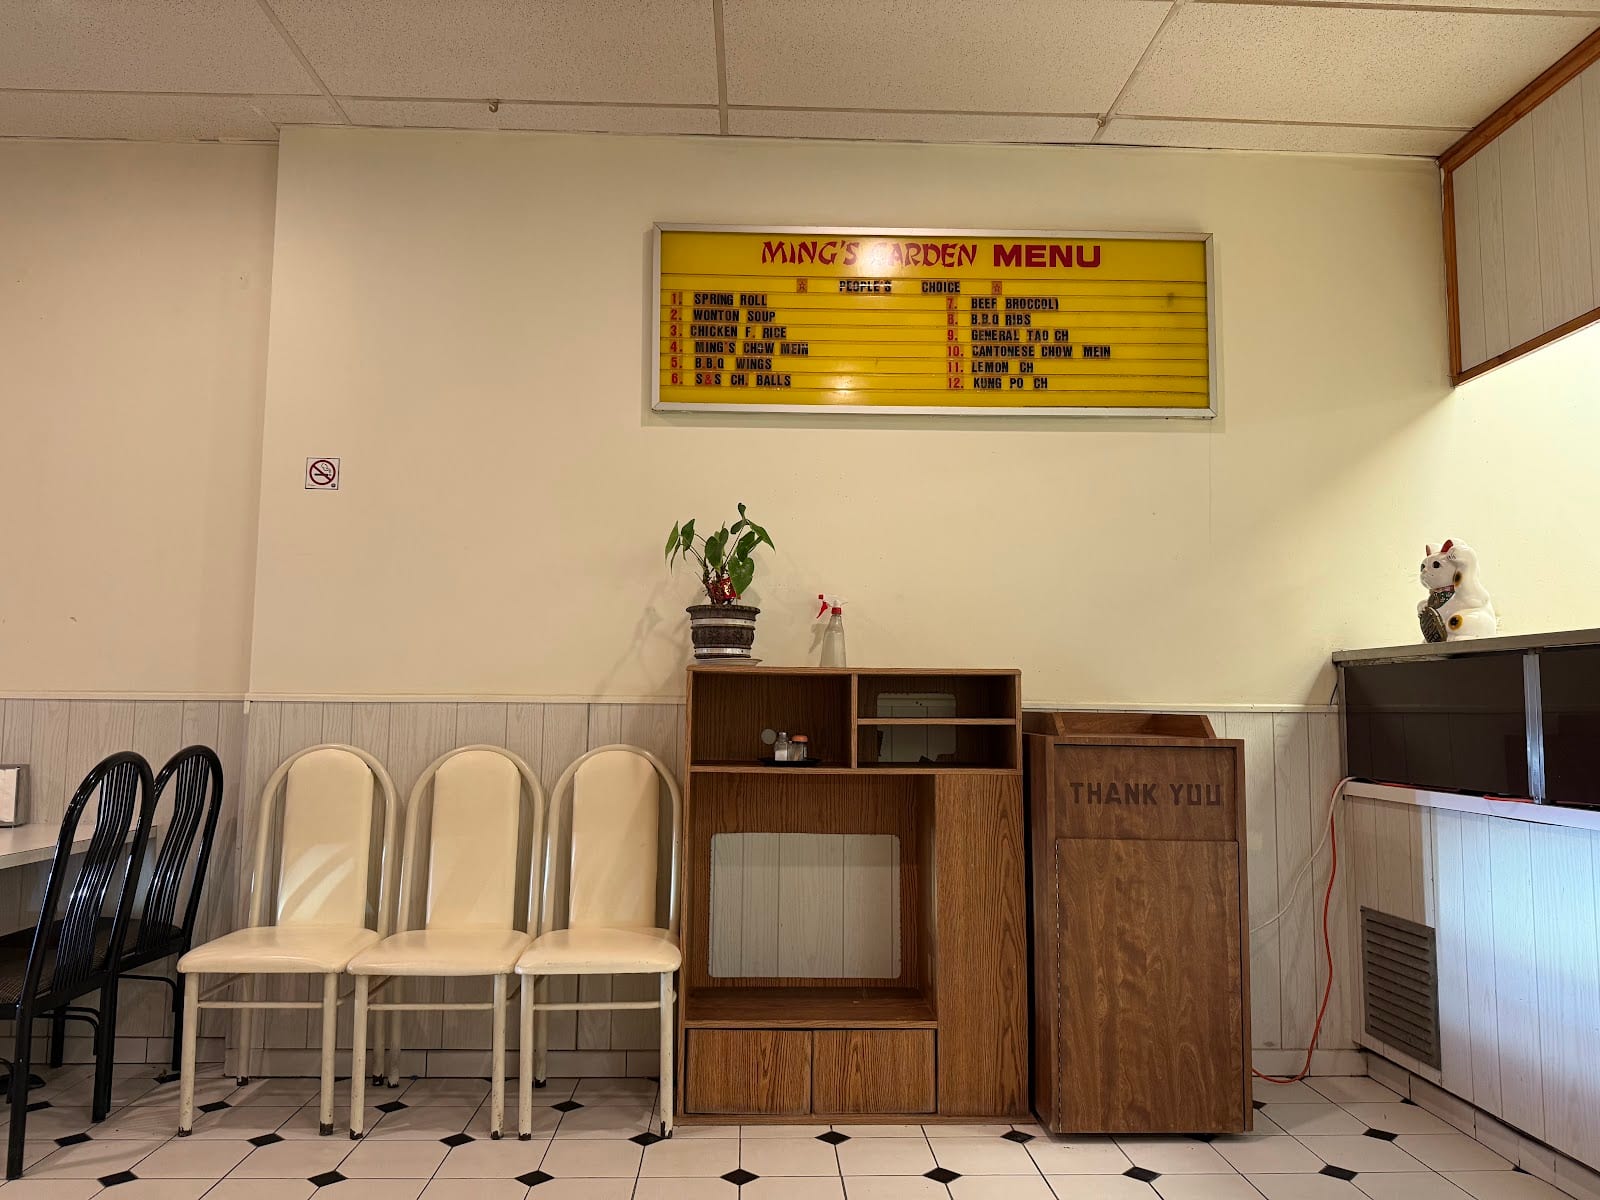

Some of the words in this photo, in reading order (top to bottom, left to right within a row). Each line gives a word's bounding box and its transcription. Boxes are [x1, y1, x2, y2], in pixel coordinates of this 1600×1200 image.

[762, 240, 859, 265] MING'S
[871, 242, 977, 268] ARDEN
[994, 244, 1101, 268] MENU
[840, 281, 892, 292] PEOPLE'S
[921, 281, 960, 293] CHOICE
[671, 293, 682, 305] 1.
[694, 294, 734, 306] SPRING
[740, 294, 767, 306] ROLL
[947, 298, 958, 309] 7.
[971, 298, 997, 309] BEEF
[670, 309, 682, 321] 2.
[693, 310, 740, 321] WONTON
[747, 310, 776, 322] SOUP
[947, 314, 958, 325] 8.
[1005, 314, 1031, 326] RIBS
[670, 325, 682, 337] 3.
[690, 325, 738, 337] CHICKEN
[745, 326, 755, 338] F.
[763, 327, 786, 338] RICE
[947, 330, 958, 341] 9.
[971, 330, 1020, 341] GENERAL
[1026, 330, 1049, 341] TAO
[1055, 330, 1069, 341] CH
[670, 341, 683, 353] 4.
[695, 342, 736, 353] MING'S
[743, 342, 774, 354] CHOW
[780, 343, 808, 355] MEIN
[947, 346, 964, 357] 10.
[972, 346, 1034, 357] CANTONESE
[1041, 346, 1073, 357] CHOW
[1083, 346, 1111, 357] MEIN
[671, 358, 682, 369] 5.
[736, 358, 772, 369] WINGS
[947, 362, 964, 373] 11.
[971, 362, 1009, 373] LEMON
[1019, 362, 1034, 373] CH
[671, 373, 683, 384] 6.
[696, 373, 721, 385] S&S
[731, 374, 748, 386] CH.
[756, 375, 791, 386] BALLS
[948, 378, 964, 389] 12.
[974, 378, 1002, 389] KUNG
[1009, 378, 1024, 389] PO
[1033, 378, 1048, 389] CH
[1070, 782, 1158, 805] THANK
[1169, 783, 1222, 806] YOU
